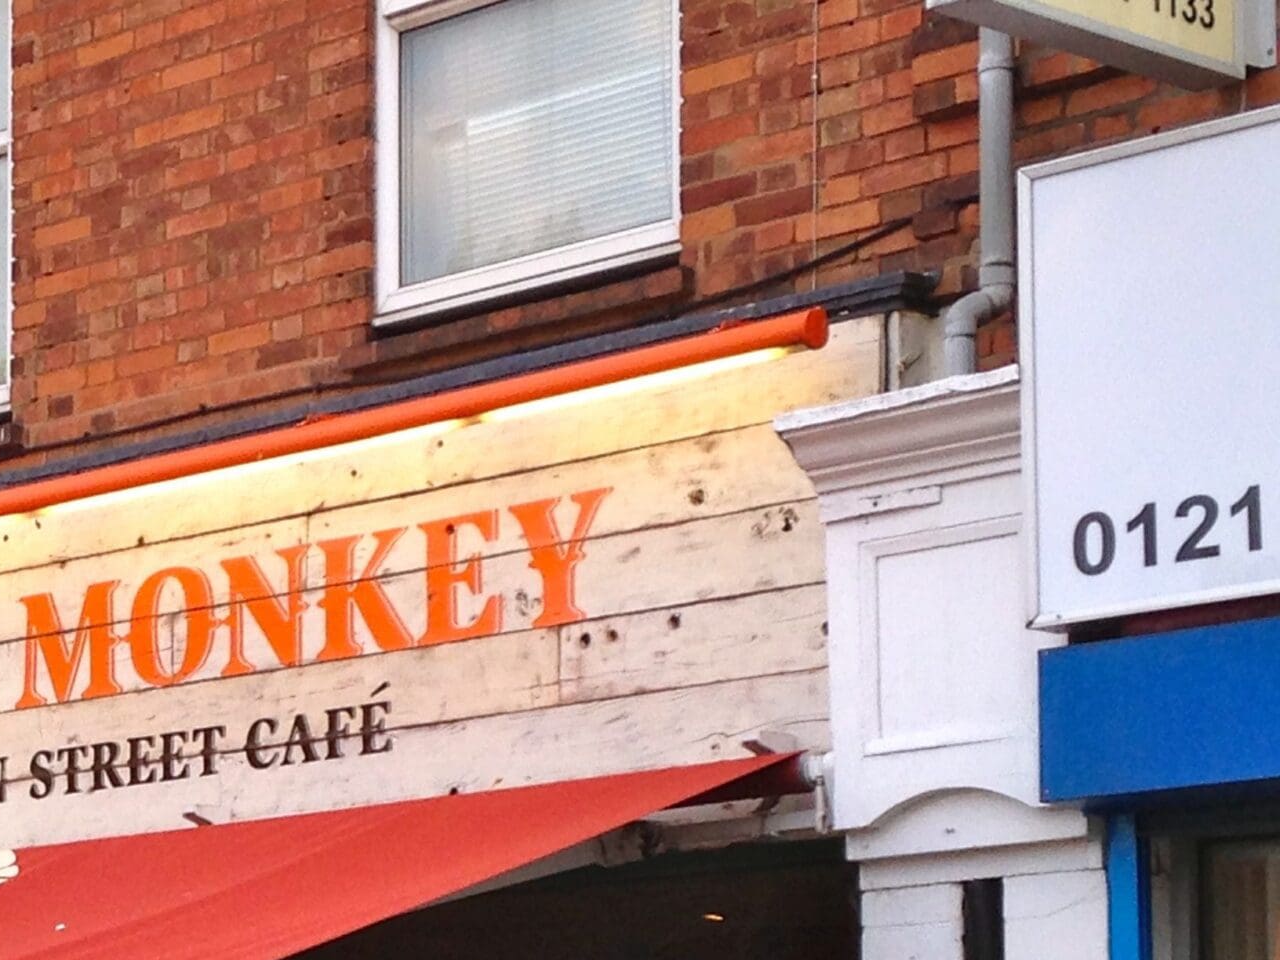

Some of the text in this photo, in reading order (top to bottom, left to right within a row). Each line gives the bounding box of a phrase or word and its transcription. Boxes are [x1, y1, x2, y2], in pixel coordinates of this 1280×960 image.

[1073, 484, 1263, 577] 0121
[15, 486, 615, 710] MONKEY
[29, 724, 226, 801] STREET
[246, 681, 394, 771] CAFÉ
